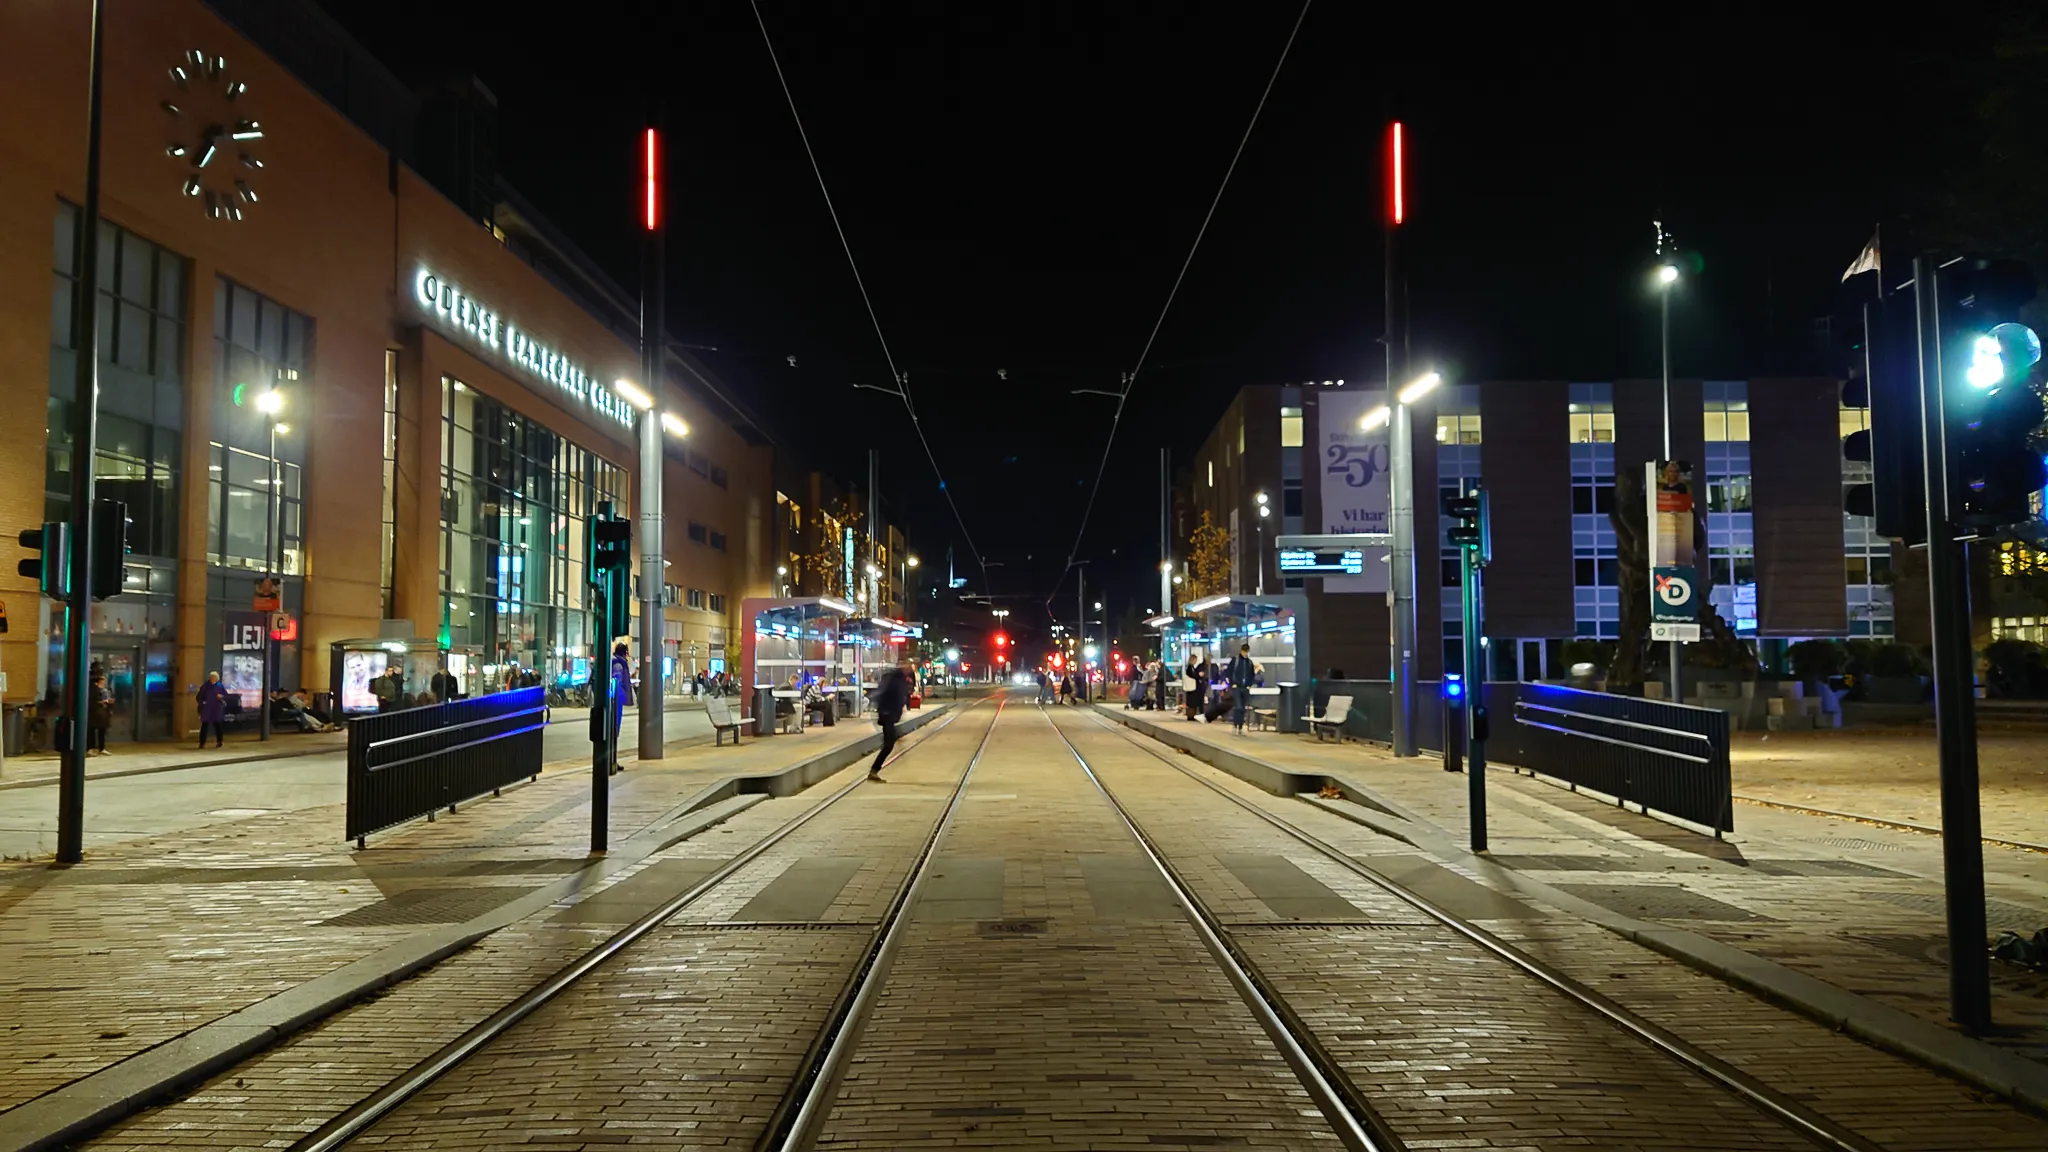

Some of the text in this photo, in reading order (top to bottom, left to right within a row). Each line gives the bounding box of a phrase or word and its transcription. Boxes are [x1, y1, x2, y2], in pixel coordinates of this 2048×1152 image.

[419, 271, 504, 346] ODENSE
[1327, 444, 1388, 487] 250
[1343, 508, 1386, 521] Vi har
[1668, 584, 1684, 599] D
[276, 617, 286, 630] C
